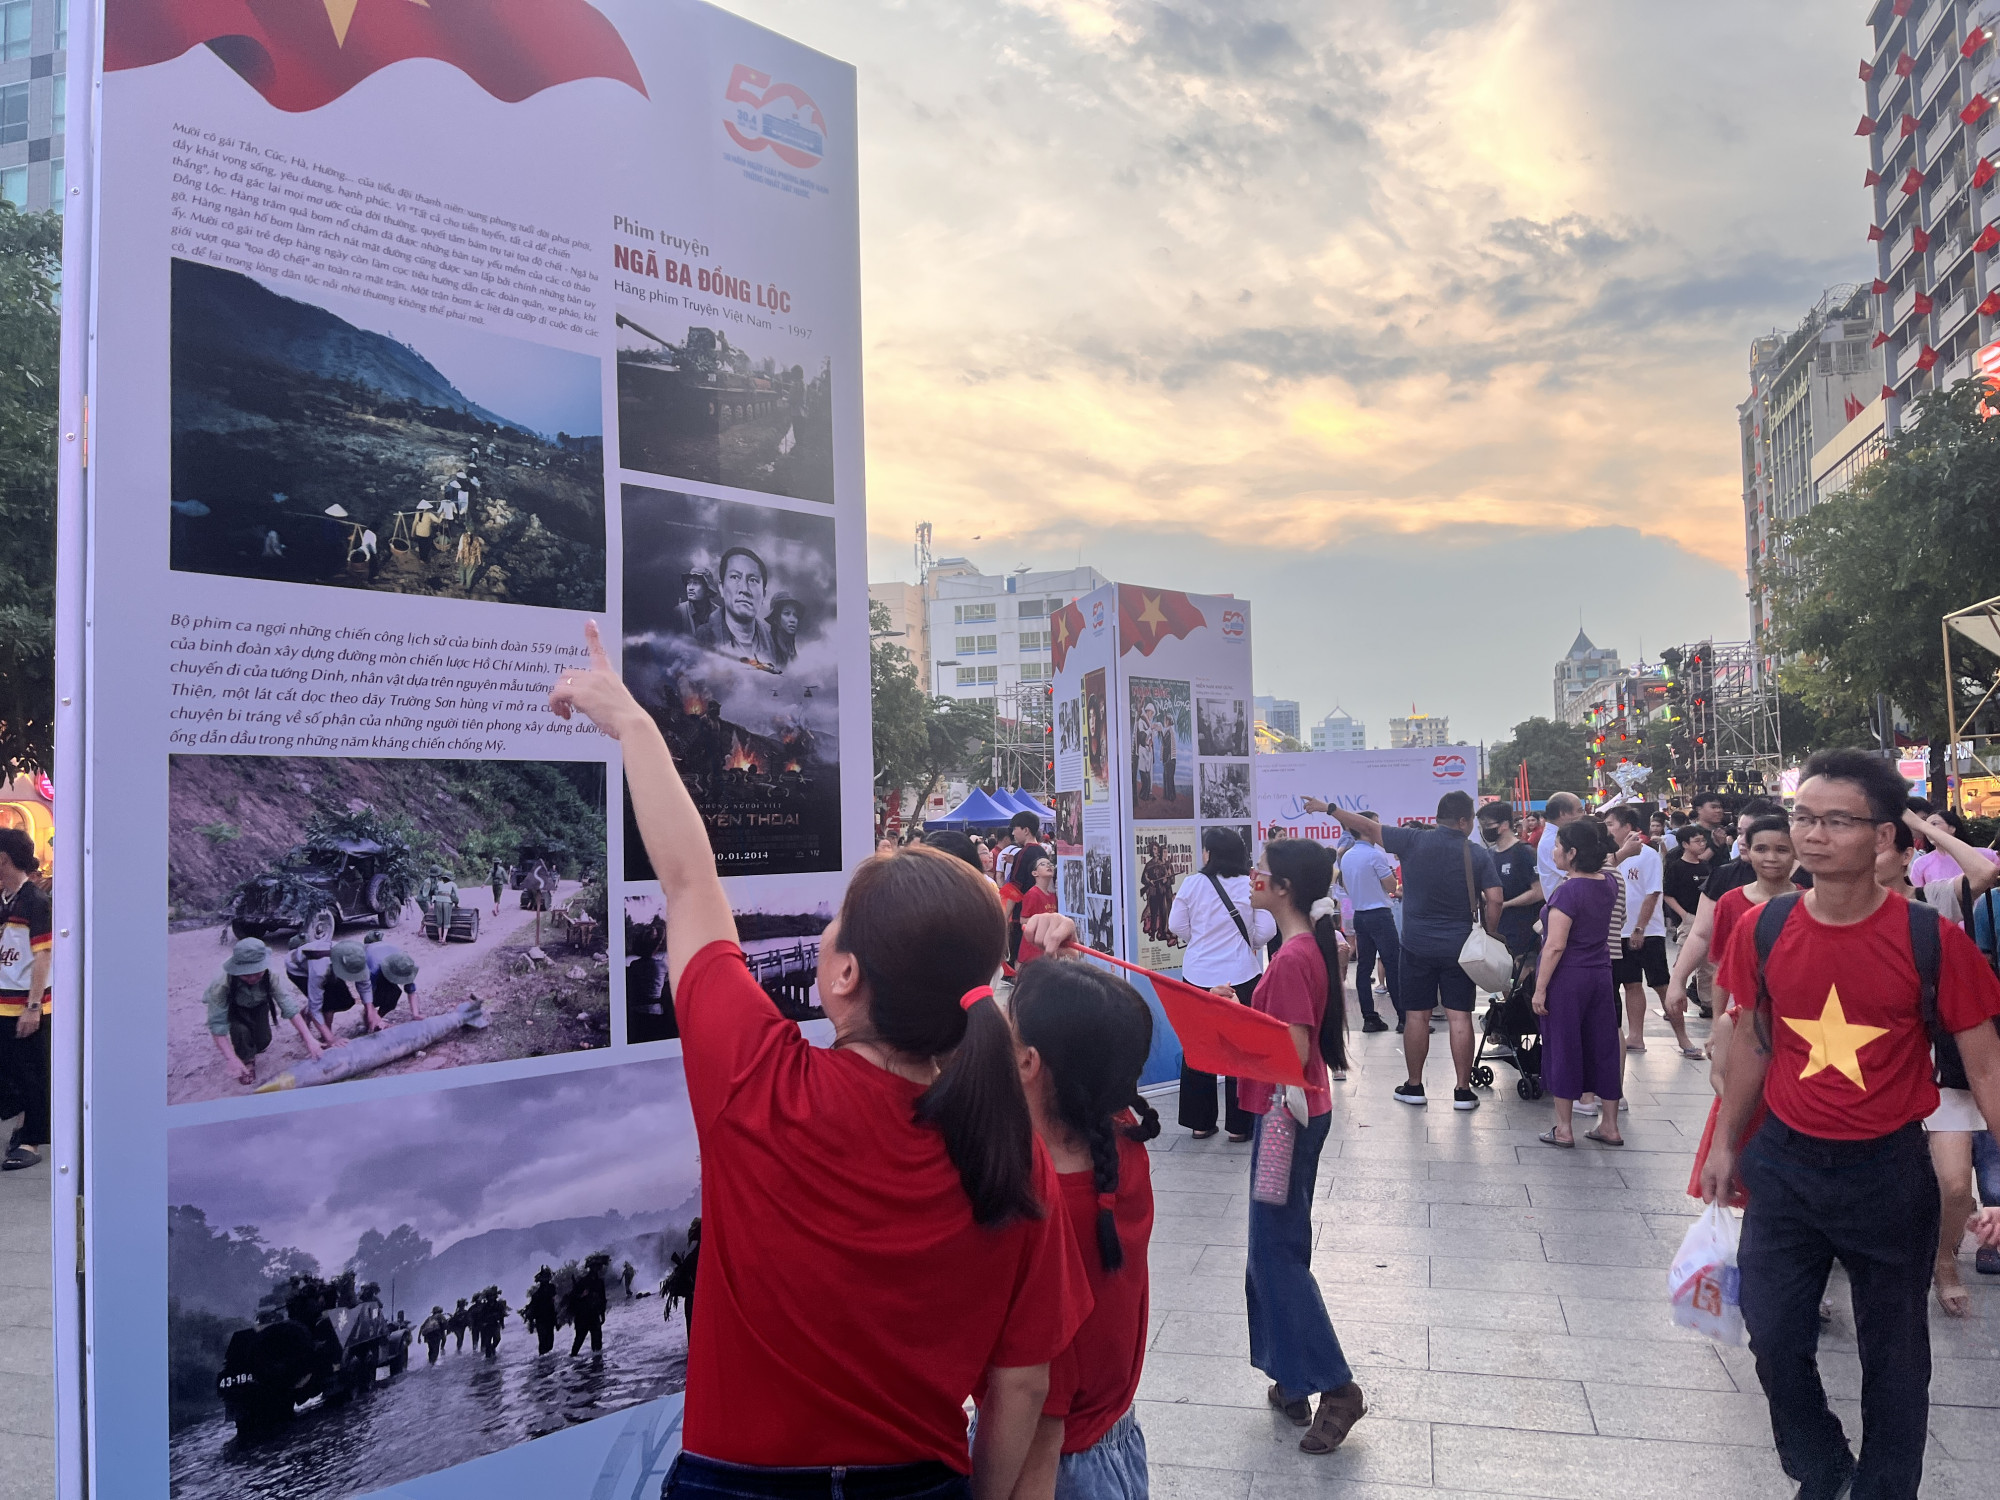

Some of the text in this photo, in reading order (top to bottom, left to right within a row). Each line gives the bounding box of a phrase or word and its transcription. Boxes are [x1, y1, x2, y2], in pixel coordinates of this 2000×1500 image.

[613, 215, 709, 258] Phim truyện
[614, 244, 791, 315] NGÃ BA ĐỒNG LỘC
[614, 279, 646, 300] Hãng
[650, 289, 679, 307] phim
[682, 297, 719, 317] Truyện
[722, 307, 744, 324] Việt
[746, 314, 772, 331] Nam
[788, 325, 813, 340] 1997
[170, 613, 190, 629] Bộ
[192, 615, 232, 631] phim
[235, 622, 252, 632] ca
[255, 622, 286, 637] ngợi
[289, 623, 332, 642] những
[334, 626, 371, 641] chiến
[374, 630, 404, 647] công
[407, 632, 430, 646] lịch
[432, 634, 448, 646] sử
[448, 635, 469, 648] của
[471, 637, 498, 650] binh
[500, 639, 528, 652] đoàn
[530, 642, 552, 654] 559
[554, 644, 578, 657] (mật
[170, 637, 196, 650] của
[199, 638, 233, 653] binh
[236, 641, 271, 655] đoàn
[274, 645, 299, 661] xây
[301, 645, 335, 663] dựng
[337, 648, 377, 666] đường
[379, 652, 407, 664] mòn
[409, 653, 443, 667] chiến
[446, 655, 470, 670] lược
[472, 656, 490, 670] Hồ
[492, 659, 513, 671] Chí
[513, 661, 550, 674] Minh).
[170, 659, 223, 677] chuyến
[226, 663, 241, 676] đi
[243, 664, 268, 678] của
[270, 666, 308, 684] tướng
[311, 668, 348, 684] Dinh,
[351, 670, 383, 684] nhân
[386, 673, 405, 687] vật
[406, 673, 429, 688] dựa
[430, 676, 454, 688] trên
[455, 679, 497, 693] nguyên
[499, 678, 524, 692] mẫu
[171, 682, 216, 699] Thiện,
[222, 686, 250, 701] một
[254, 686, 273, 700] lát
[276, 687, 297, 702] cắt
[301, 689, 326, 704] dọc
[330, 690, 359, 704] theo
[362, 692, 386, 709] dãy
[390, 694, 431, 711] Trường
[434, 696, 456, 708] Sơn
[459, 697, 489, 713] hùng
[492, 700, 504, 711] vĩ
[505, 699, 525, 711] mở
[526, 703, 538, 712] ra
[169, 705, 223, 724] chuyện
[227, 708, 242, 721] bi
[245, 710, 282, 727] tráng
[285, 709, 302, 724] về
[304, 710, 322, 724] số
[321, 712, 356, 728] phận
[359, 713, 381, 726] của
[384, 714, 423, 732] những
[426, 717, 459, 732] người
[461, 718, 484, 730] tiên
[485, 718, 522, 735] phong
[523, 720, 544, 735] xây
[546, 720, 573, 736] dựng
[169, 728, 506, 754] ống dẫn dầu trong những năm kháng chiến chống Mỹ.
[1305, 822, 1341, 840] mùa
